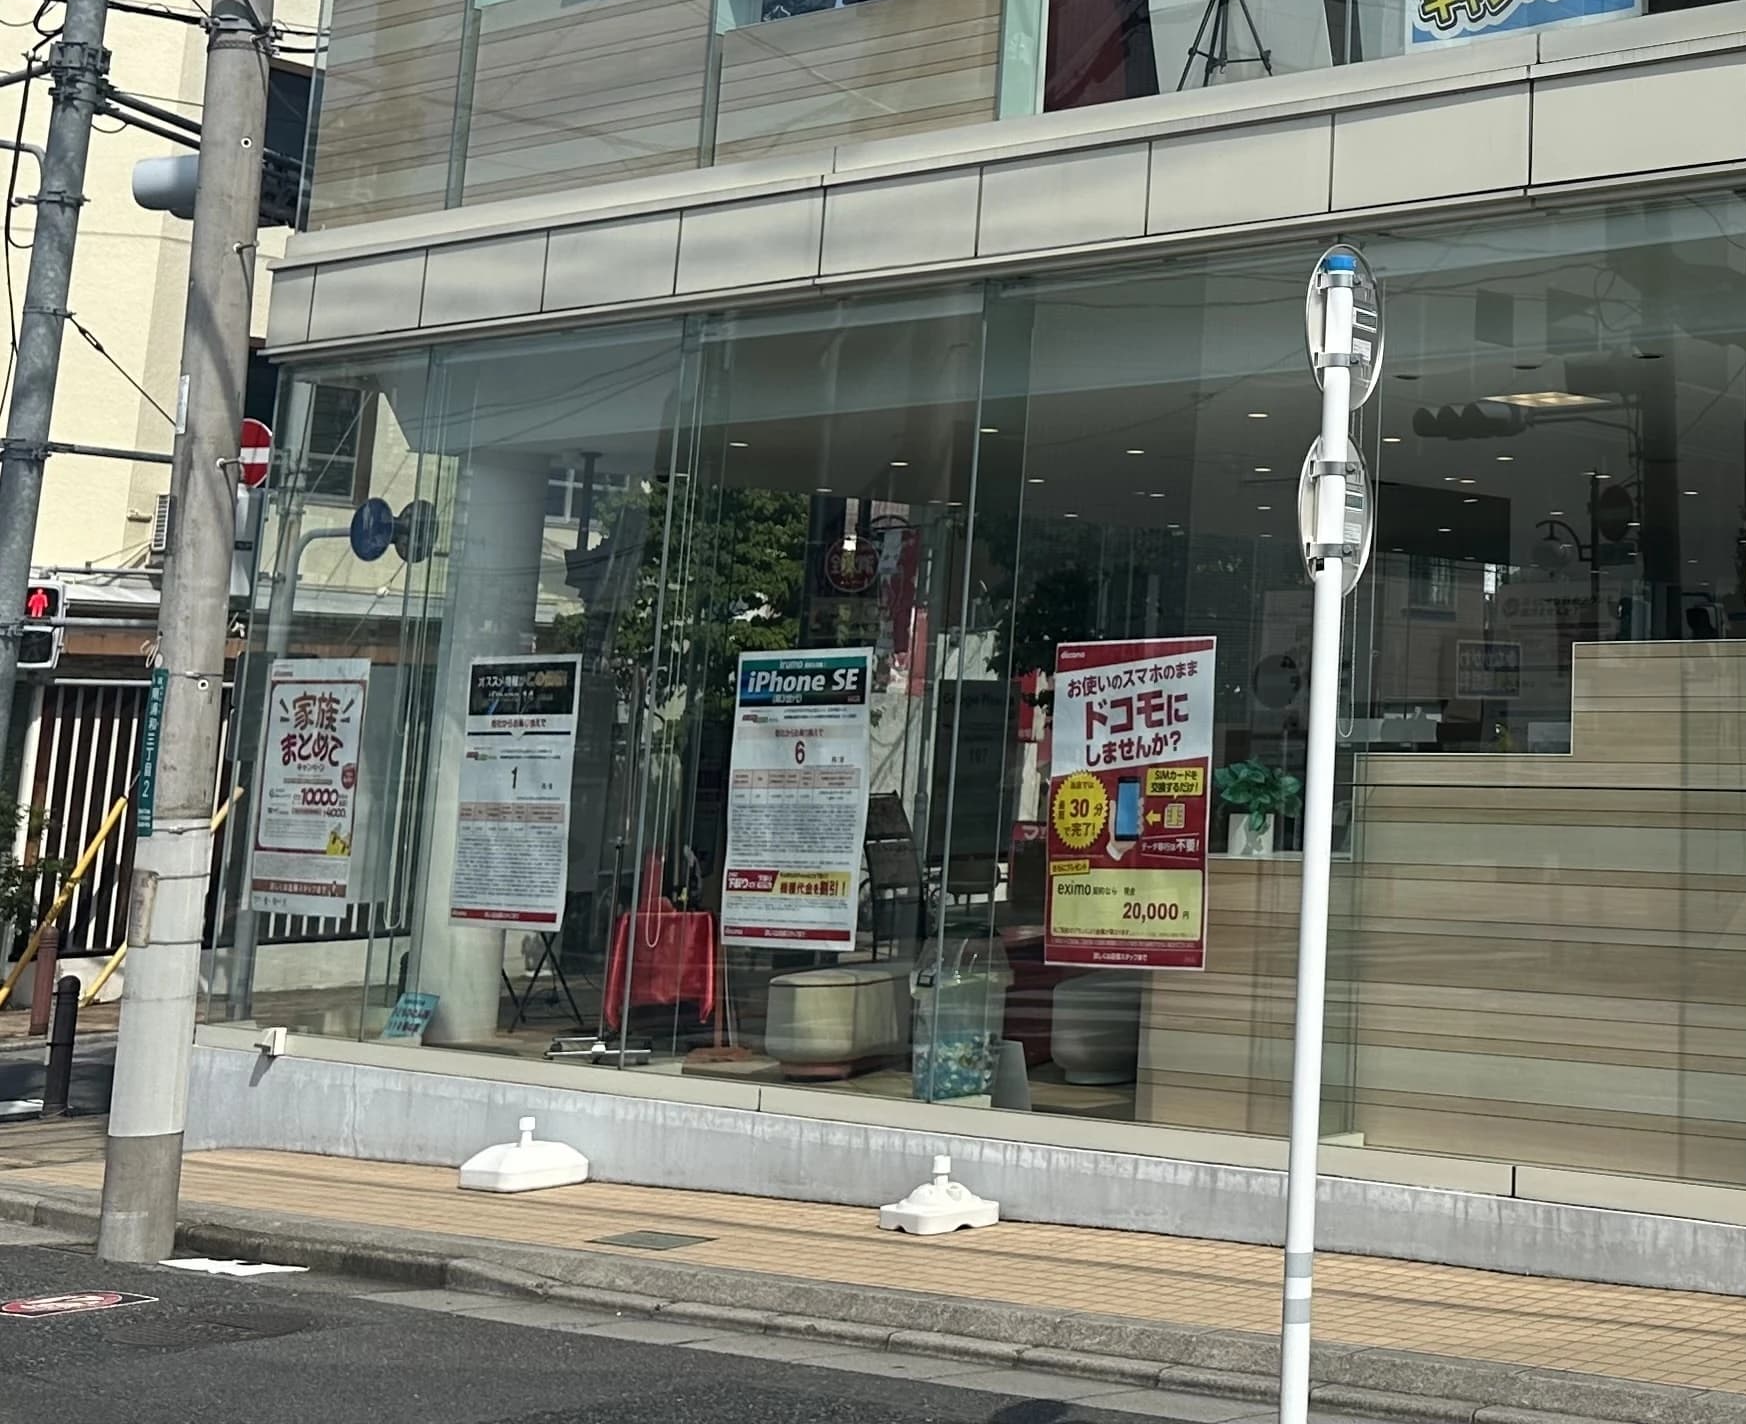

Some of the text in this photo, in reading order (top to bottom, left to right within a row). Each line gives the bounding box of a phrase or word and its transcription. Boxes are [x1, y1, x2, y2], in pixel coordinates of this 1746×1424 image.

[747, 668, 860, 693] iPhone SE
[1067, 660, 1199, 698] お使いのスマホのまま
[292, 691, 341, 732] 家族
[1085, 689, 1190, 740] ドコモに
[280, 731, 344, 767] まとめて
[794, 740, 806, 765] 6
[1085, 730, 1182, 767] しませんか?
[142, 780, 153, 798] 2
[1069, 798, 1090, 818] 30
[1093, 802, 1104, 817] 分
[1064, 822, 1096, 837] で完了!
[1122, 901, 1179, 924] 20,000
